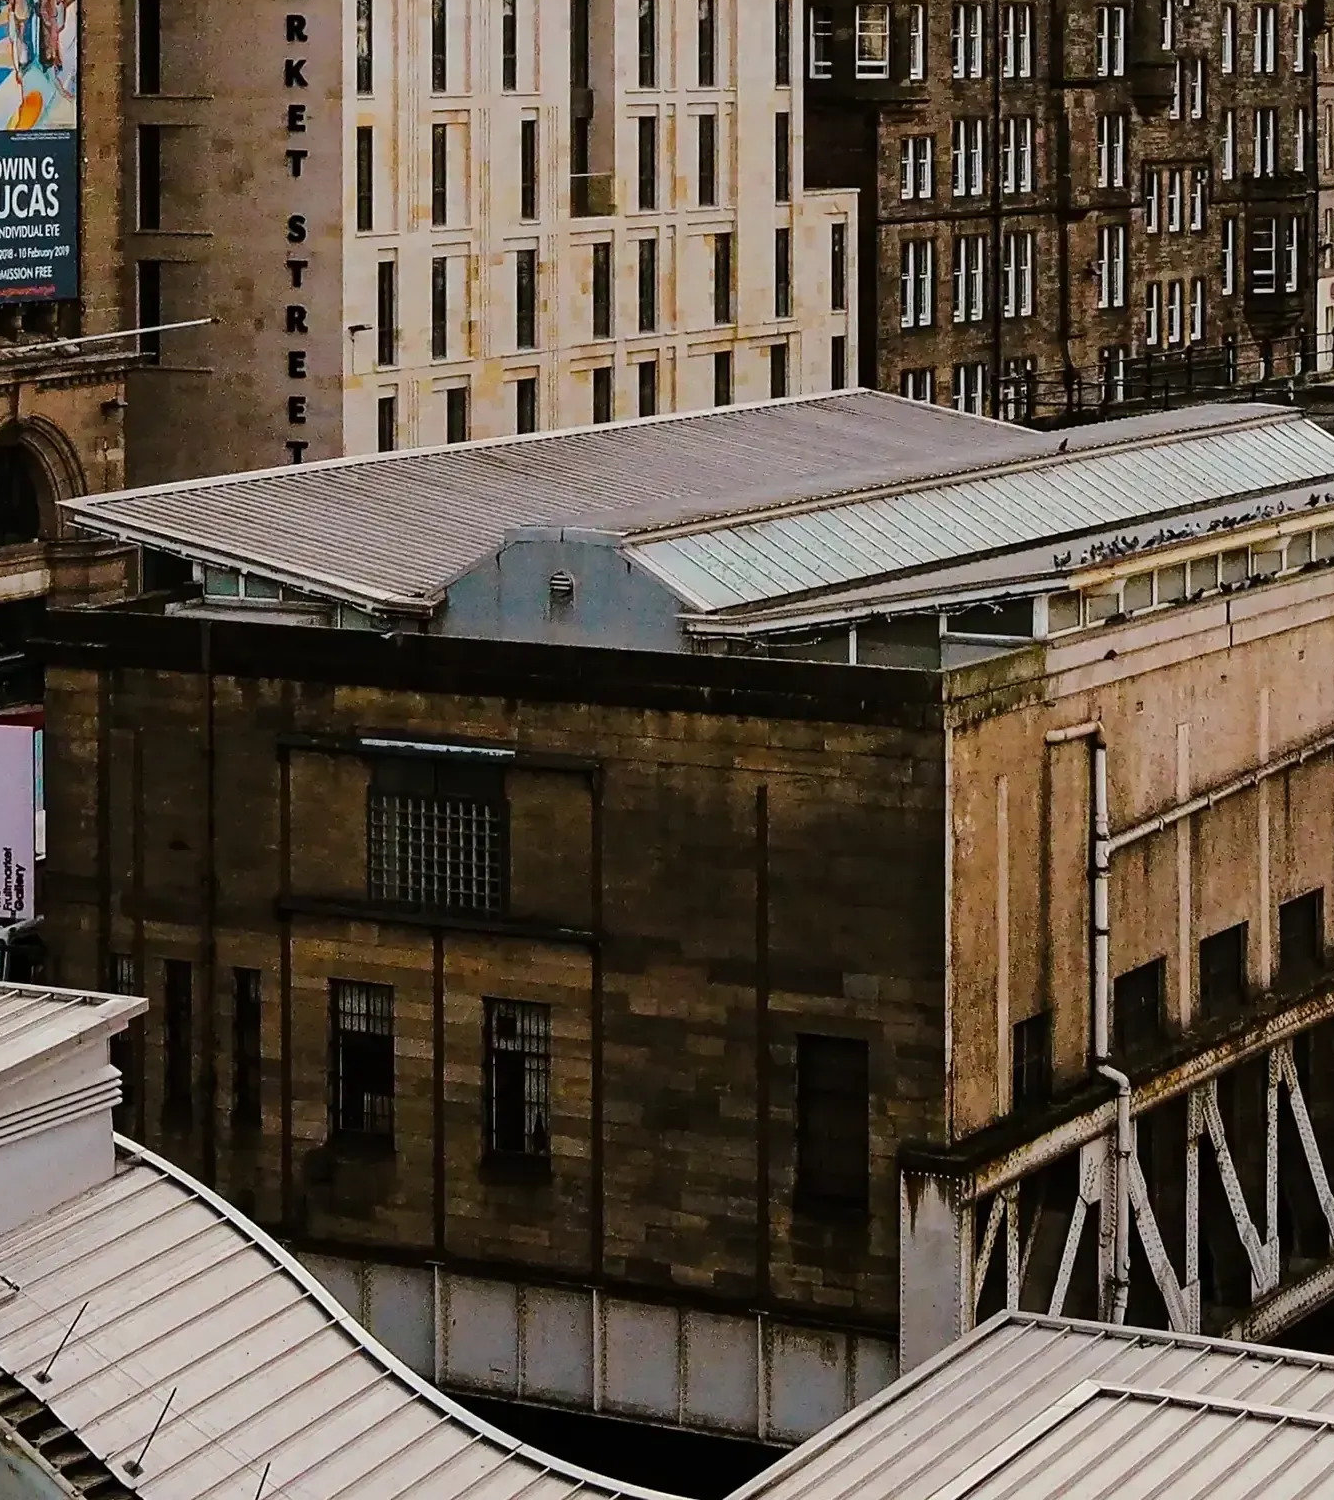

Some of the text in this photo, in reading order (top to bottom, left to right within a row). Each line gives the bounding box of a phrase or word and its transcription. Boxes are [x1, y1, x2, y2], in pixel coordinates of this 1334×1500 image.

[41, 156, 60, 180] G.
[45, 223, 61, 237] EYE
[18, 247, 27, 259] 10
[27, 247, 54, 260] February
[53, 245, 70, 257] 2019
[34, 265, 53, 279] FREE
[284, 213, 309, 465] STREET
[3, 847, 13, 911] Fruitmarket
[14, 863, 27, 911] Gallery
